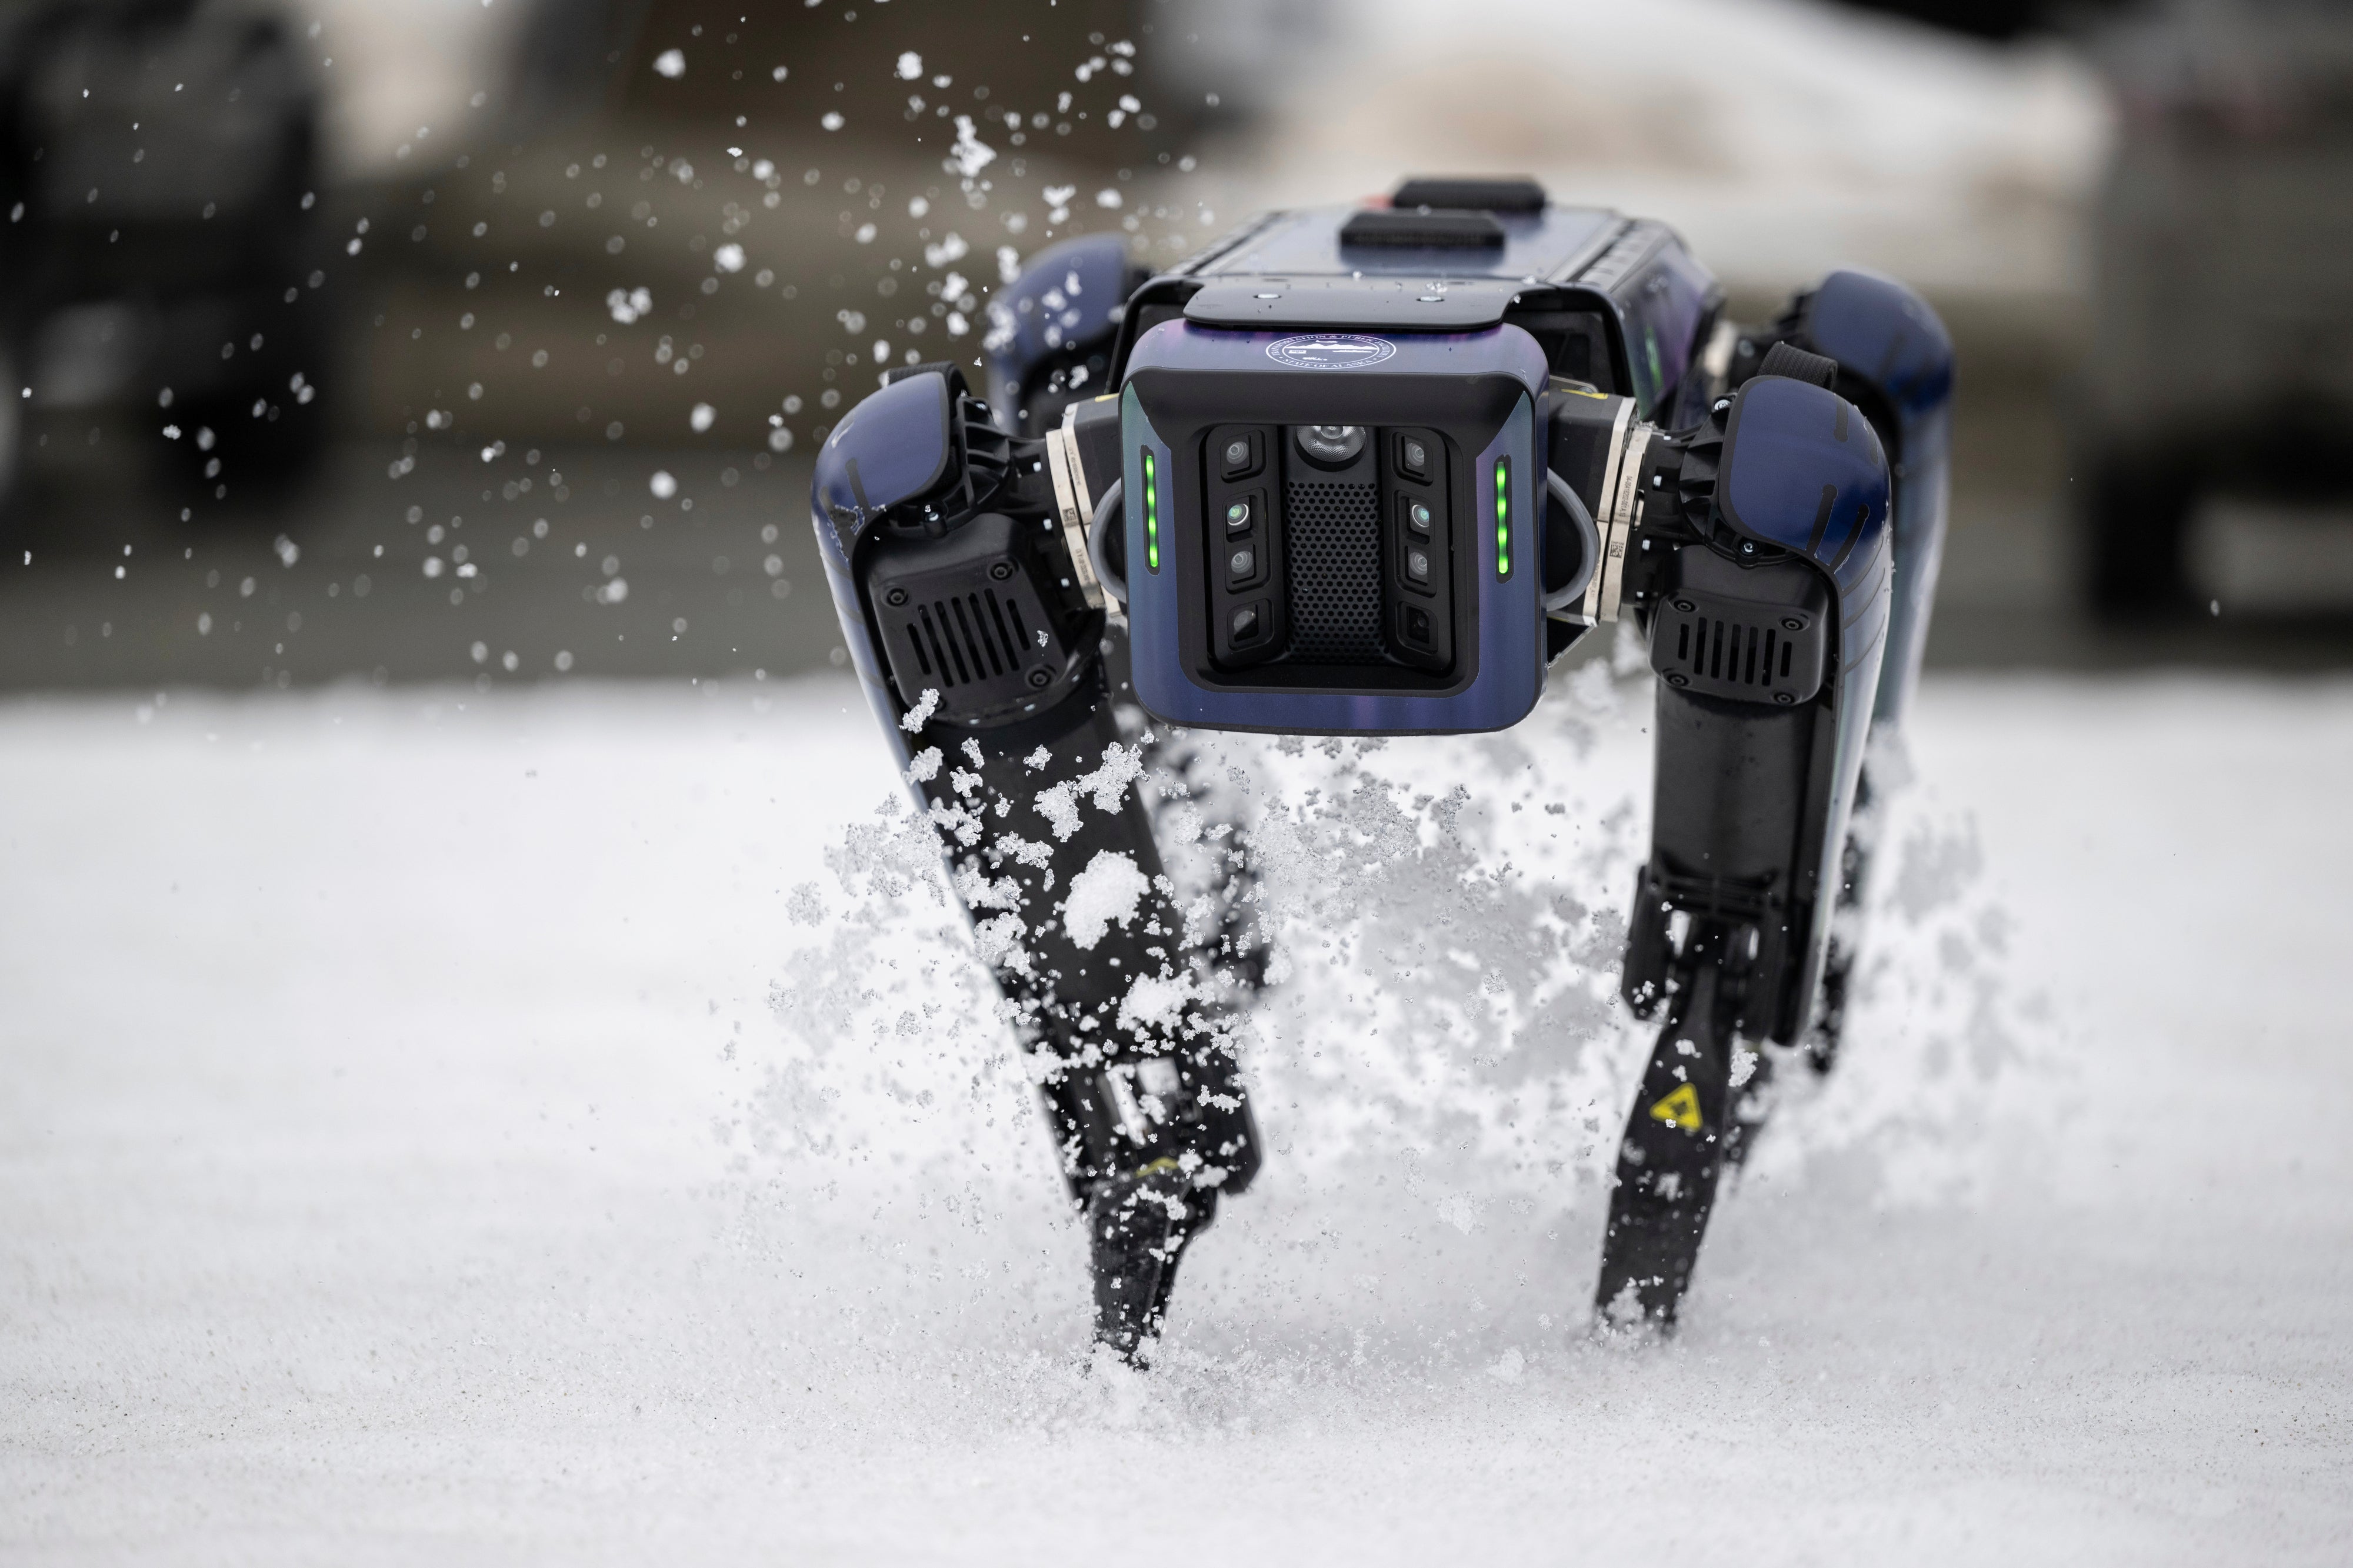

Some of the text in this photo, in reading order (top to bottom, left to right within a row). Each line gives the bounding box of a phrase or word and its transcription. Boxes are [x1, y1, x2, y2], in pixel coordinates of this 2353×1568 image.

[1271, 335, 1326, 356] TRANSPORTATION
[1374, 341, 1391, 358] FACILITIES
[1283, 359, 1312, 367] STATE
[1331, 359, 1372, 368] ALASKA
